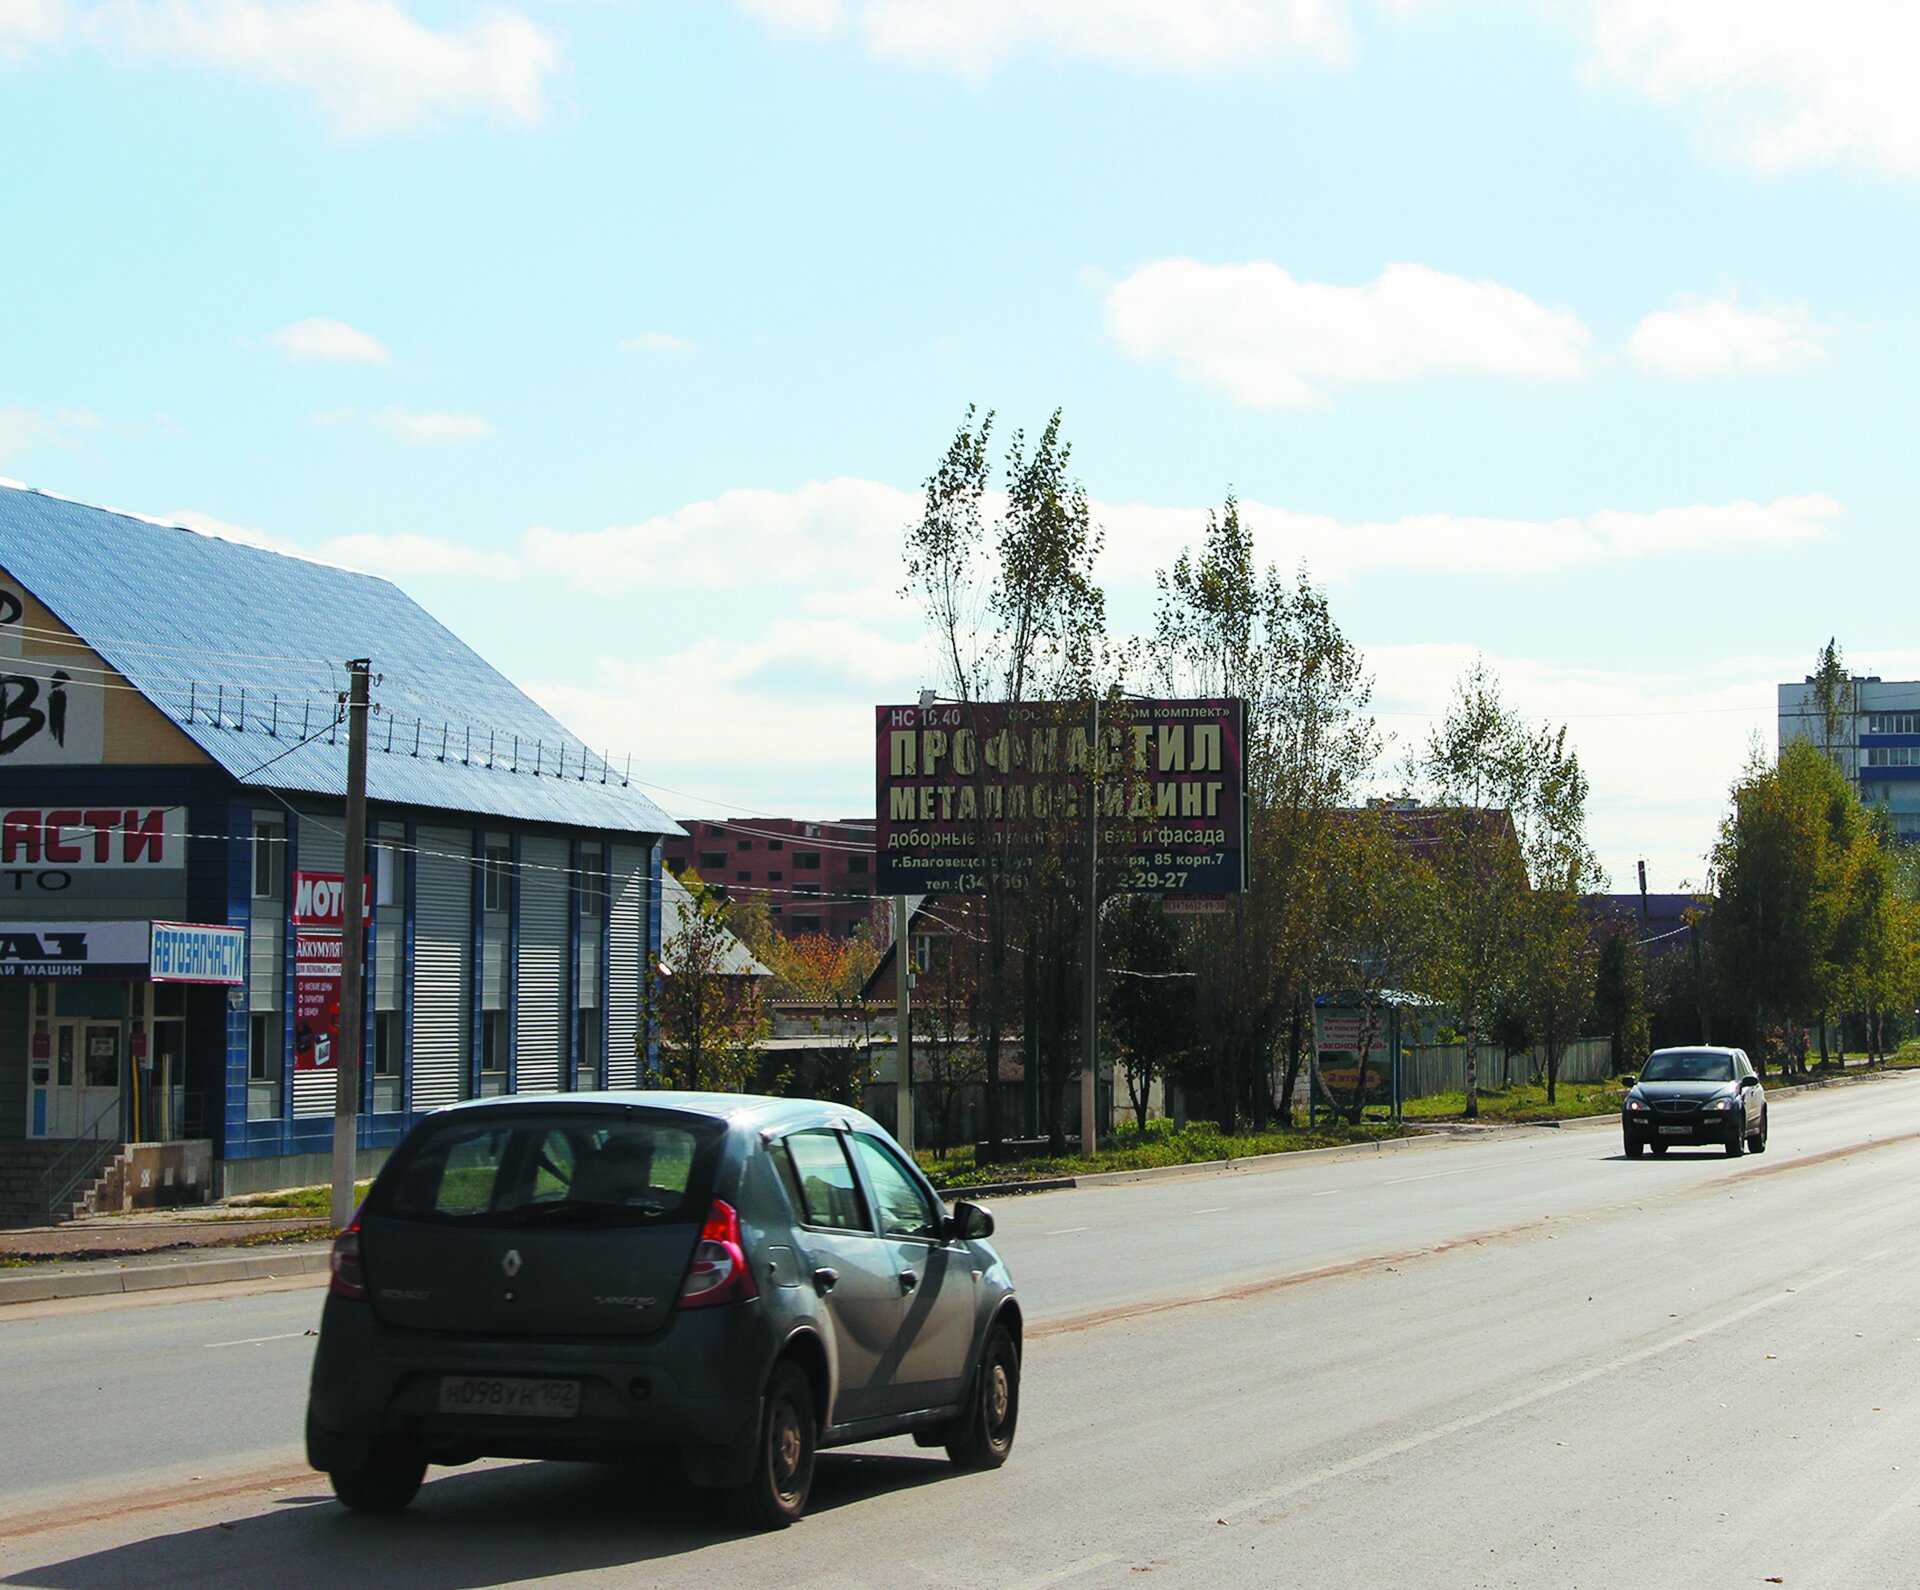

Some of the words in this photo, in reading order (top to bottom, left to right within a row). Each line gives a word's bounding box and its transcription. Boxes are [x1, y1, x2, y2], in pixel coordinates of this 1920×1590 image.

[1154, 707, 1230, 719] комплект»
[890, 724, 1221, 776] ПРОФНАСТИЛ
[889, 782, 1222, 820] МЕТАЛЛОСЙДИНГ
[888, 829, 976, 849] доборные
[1157, 826, 1226, 848] фасада
[1154, 853, 1172, 865] 85
[1176, 853, 1224, 868] корп.7
[294, 879, 370, 918] MOTL
[153, 930, 243, 976] АВТОЗАПЧАСТИ
[23, 965, 82, 975] МАШИН
